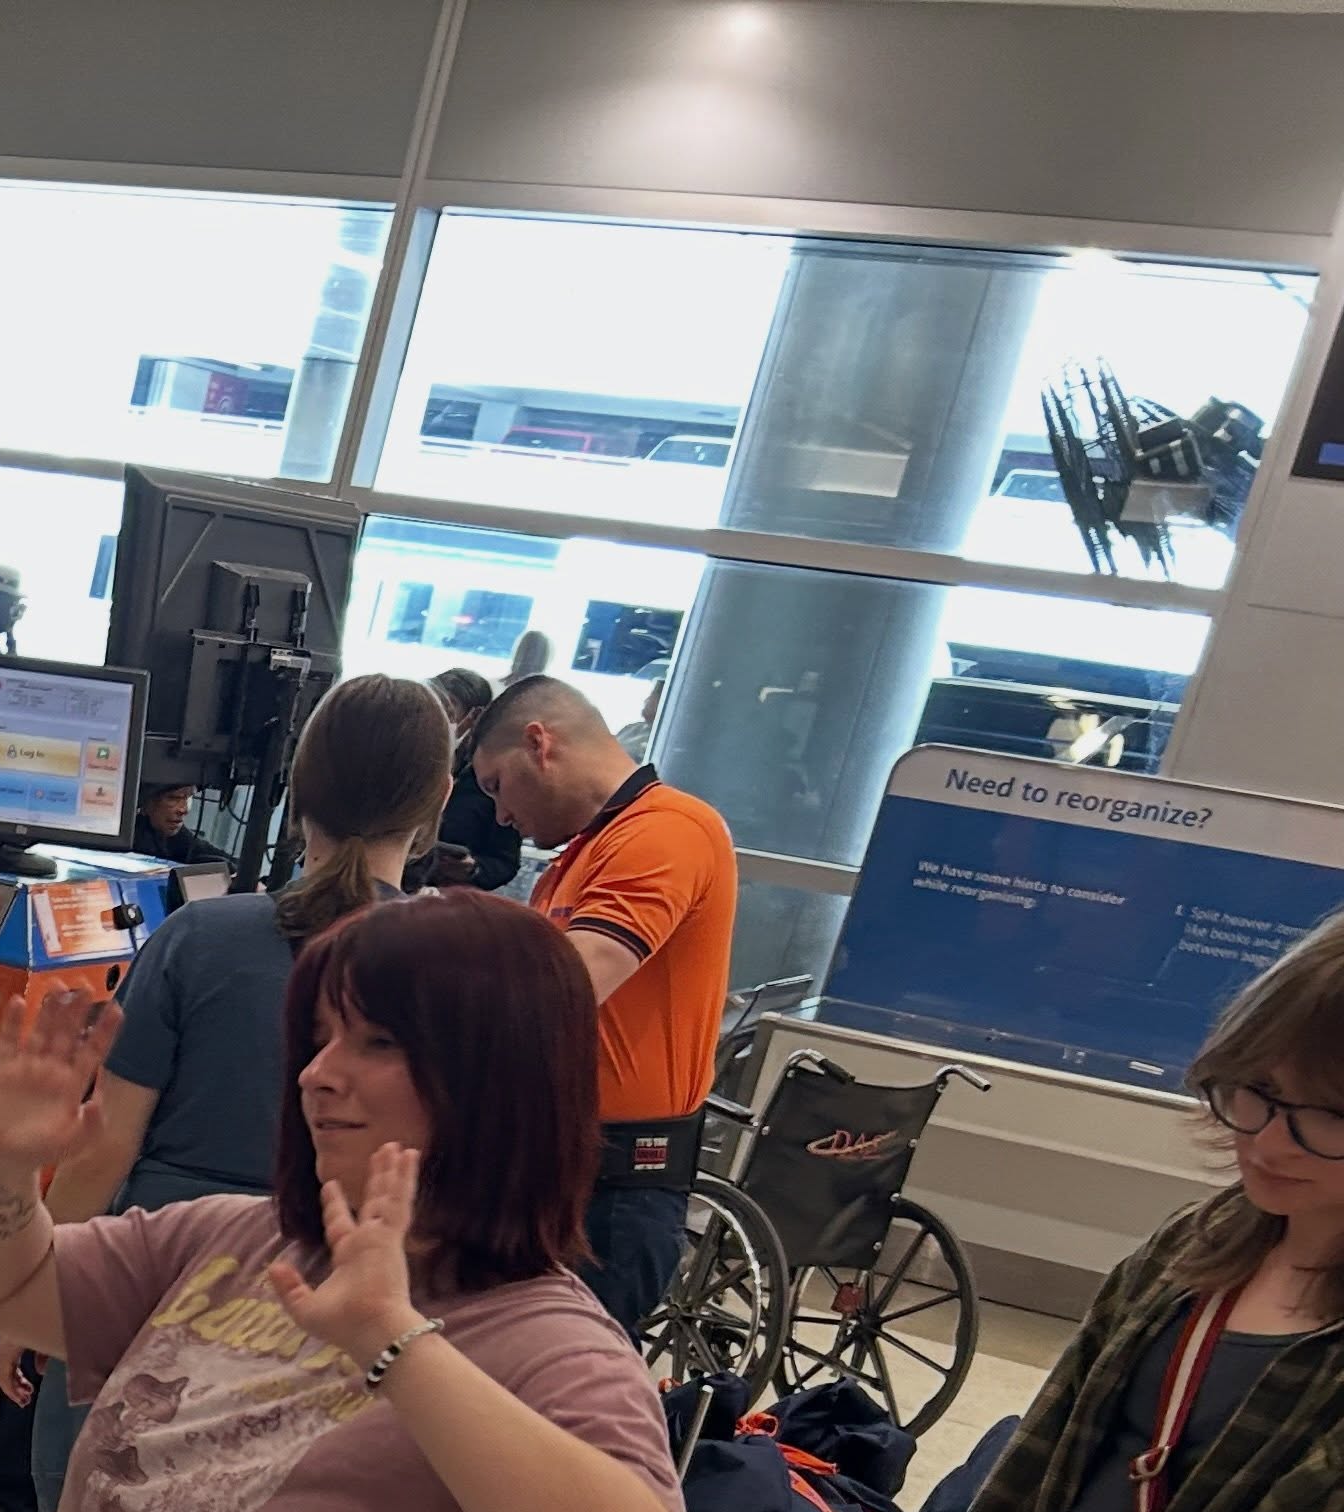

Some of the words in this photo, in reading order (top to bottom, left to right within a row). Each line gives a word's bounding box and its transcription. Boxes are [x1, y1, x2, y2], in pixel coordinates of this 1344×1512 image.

[944, 767, 1016, 799] Need
[1022, 781, 1049, 804] to
[1055, 789, 1213, 828] reorganize?
[941, 864, 974, 880] have
[974, 872, 1011, 886] some
[1050, 884, 1065, 896] to
